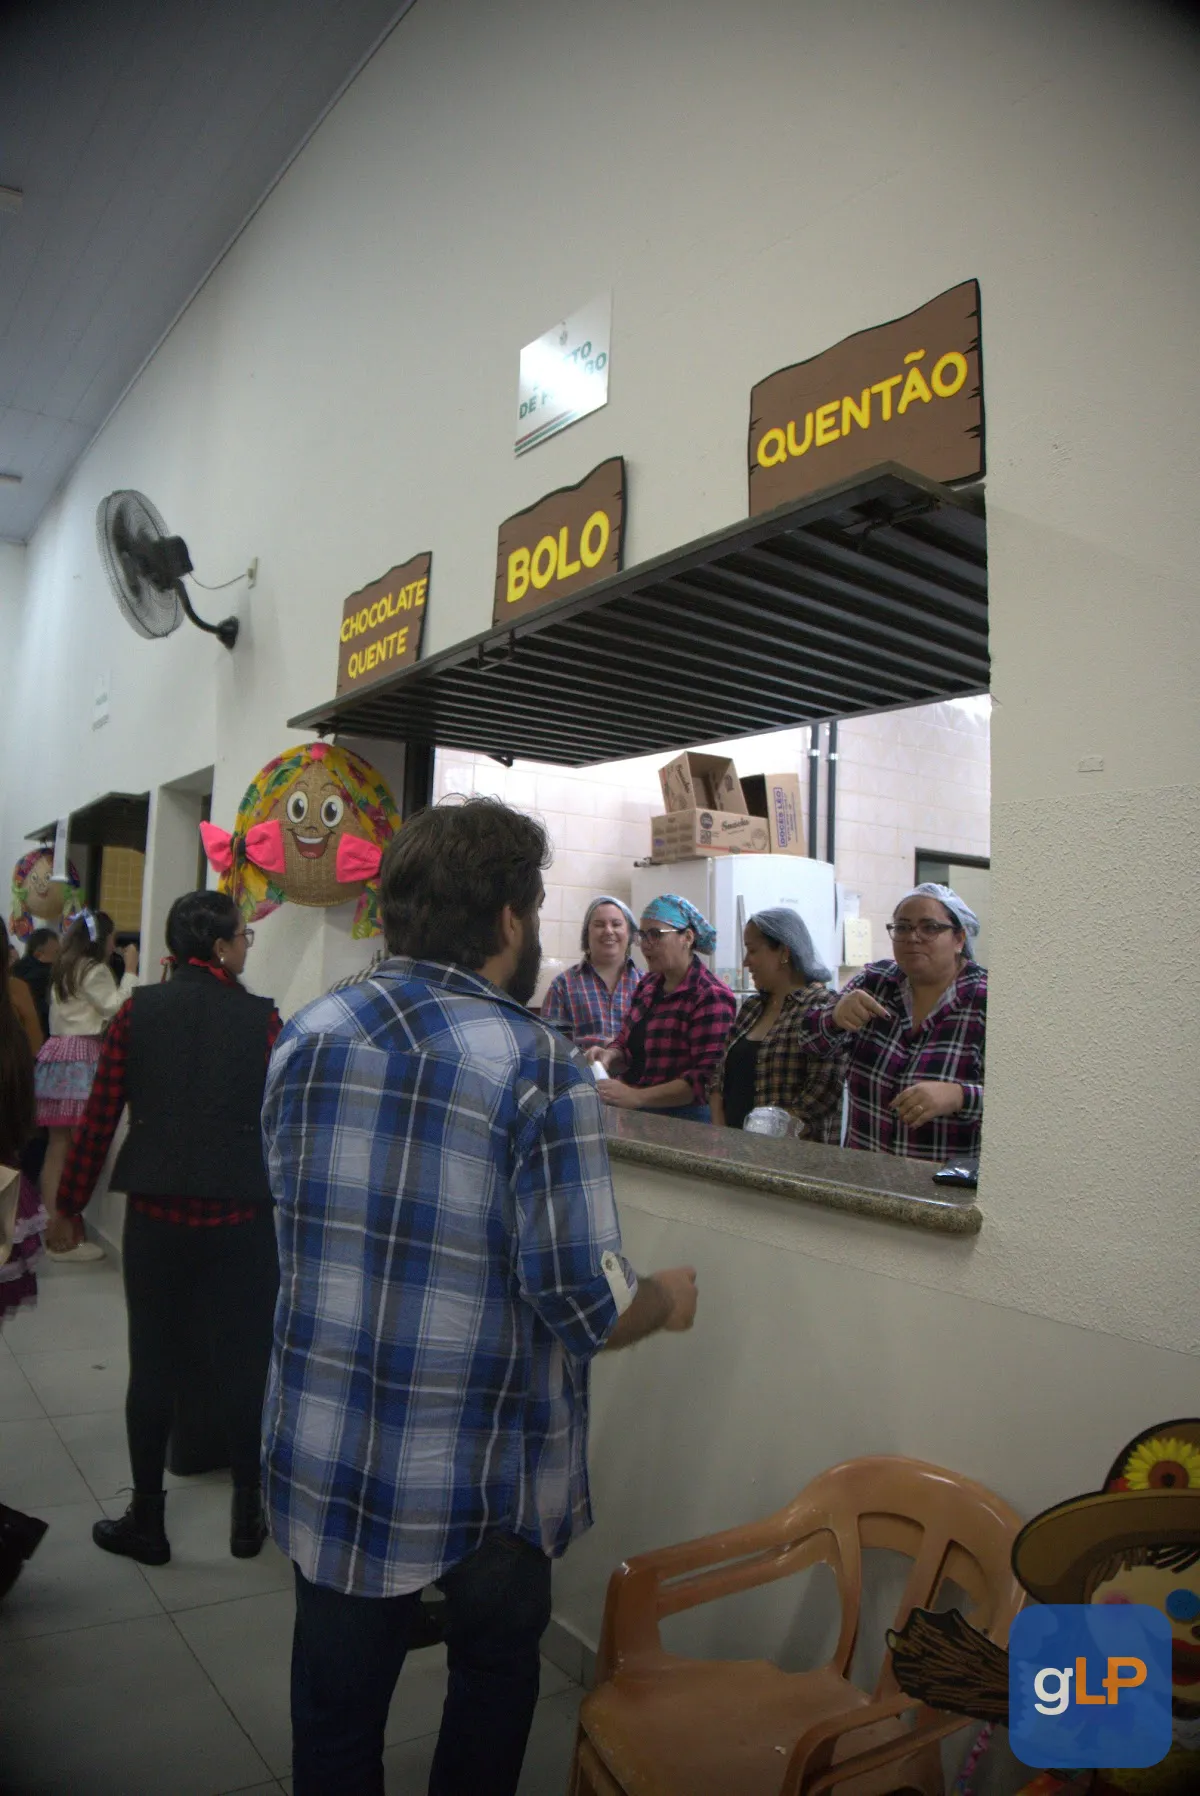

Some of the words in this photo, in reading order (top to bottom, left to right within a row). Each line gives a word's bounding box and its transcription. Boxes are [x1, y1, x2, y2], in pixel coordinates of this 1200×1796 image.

[757, 349, 968, 467] QUENTÃO
[507, 511, 609, 603] BOLO
[340, 577, 428, 642] CHOCOLATE
[348, 626, 409, 679] QUENTE
